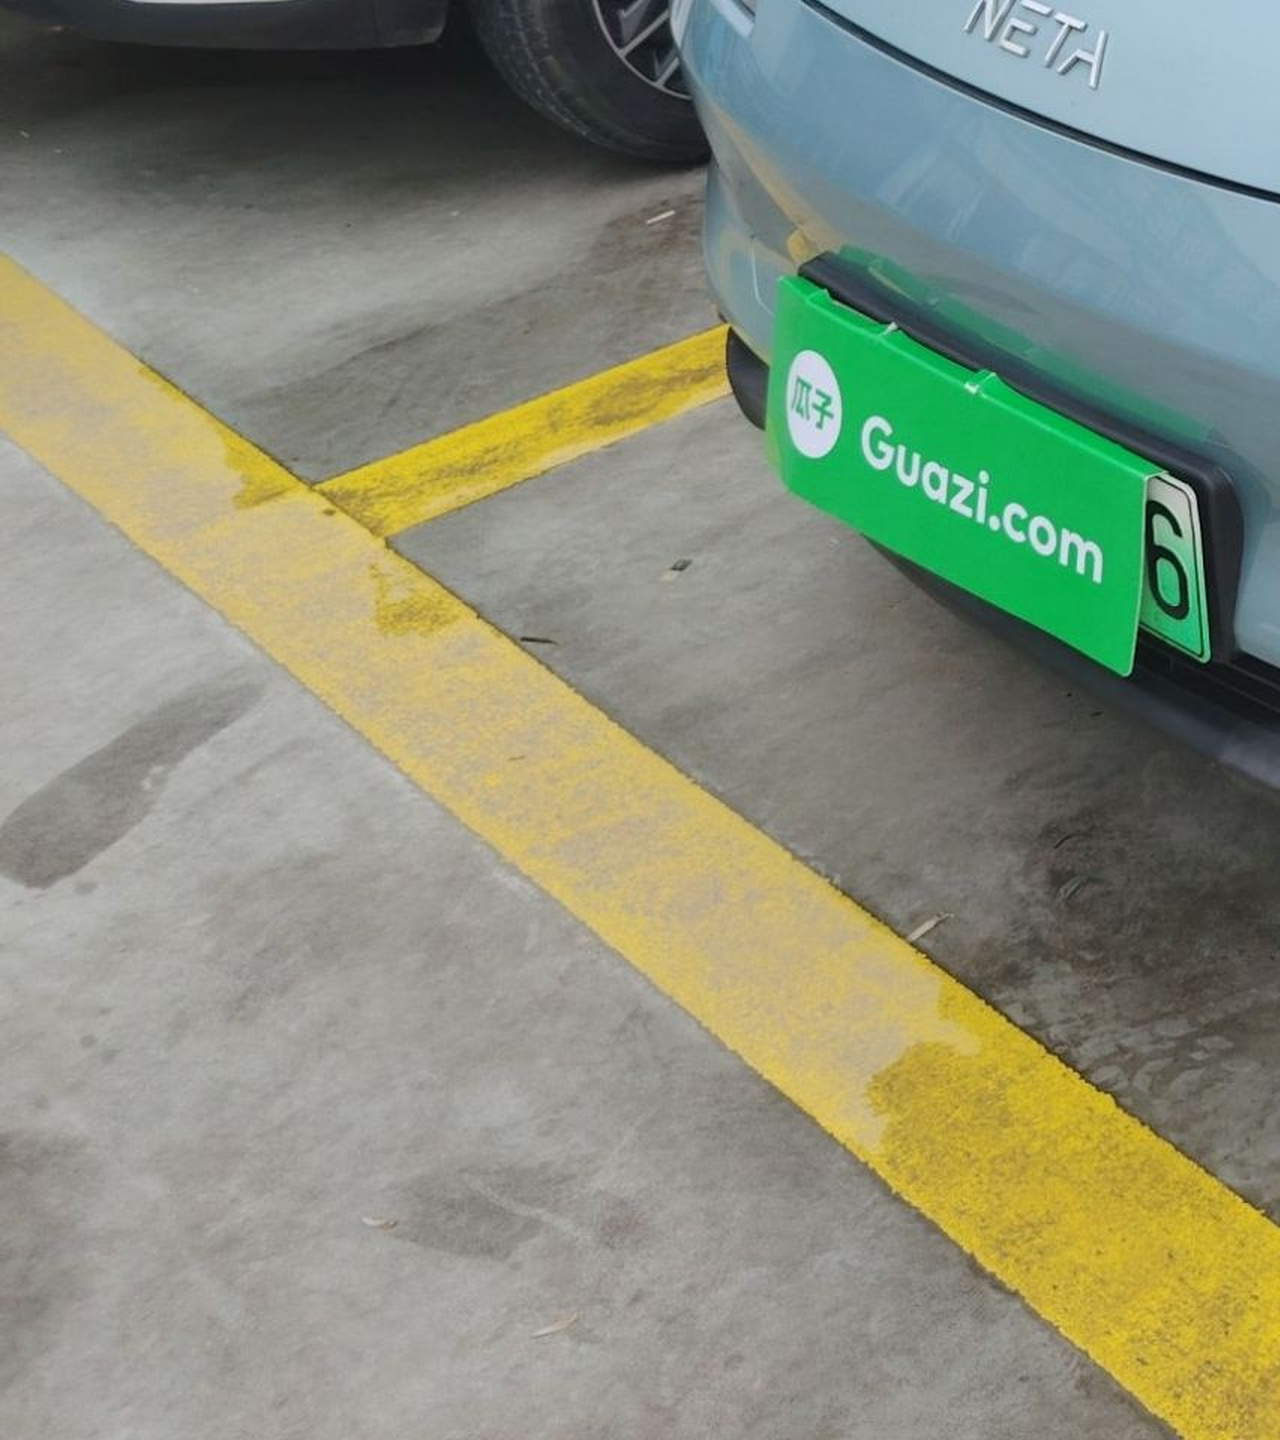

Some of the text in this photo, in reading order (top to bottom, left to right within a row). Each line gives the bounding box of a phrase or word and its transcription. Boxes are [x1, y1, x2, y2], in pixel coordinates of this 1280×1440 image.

[790, 376, 836, 431] 瓜子
[860, 414, 1104, 586] Guazi.com
[1146, 499, 1190, 622] 6
